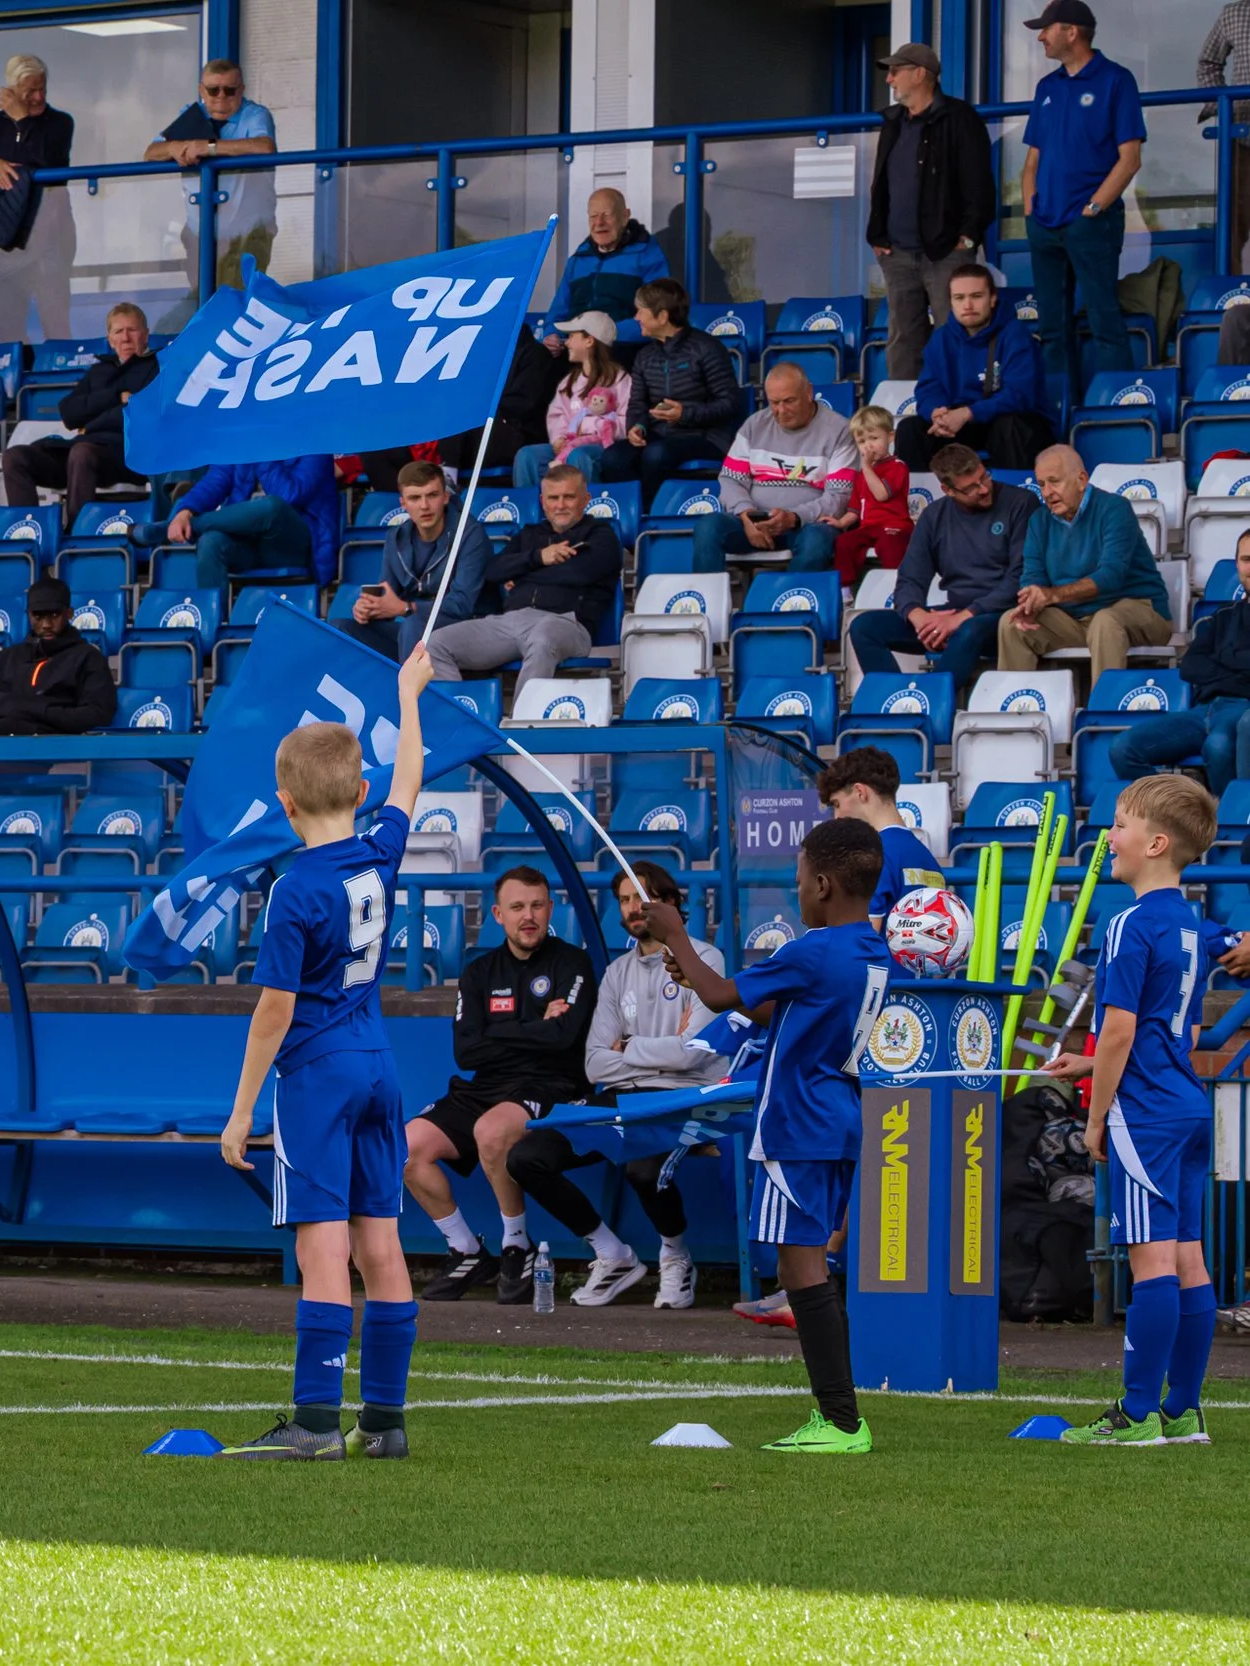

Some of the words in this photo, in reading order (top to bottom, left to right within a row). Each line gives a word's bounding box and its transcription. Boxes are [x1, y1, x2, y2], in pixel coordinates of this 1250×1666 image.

[753, 799, 778, 807] CURZON
[779, 798, 803, 806] ASHTON
[747, 820, 822, 847] HOM
[342, 868, 387, 989] 9
[896, 920, 923, 928] Mitre
[901, 996, 933, 1032] ASHTON
[952, 996, 975, 1028] CURZON
[977, 999, 997, 1035] ASHTON
[887, 1171, 900, 1277] ELECTRICAL
[968, 1174, 977, 1278] ELECTRICAL
[365, 1436, 383, 1449] CR7
